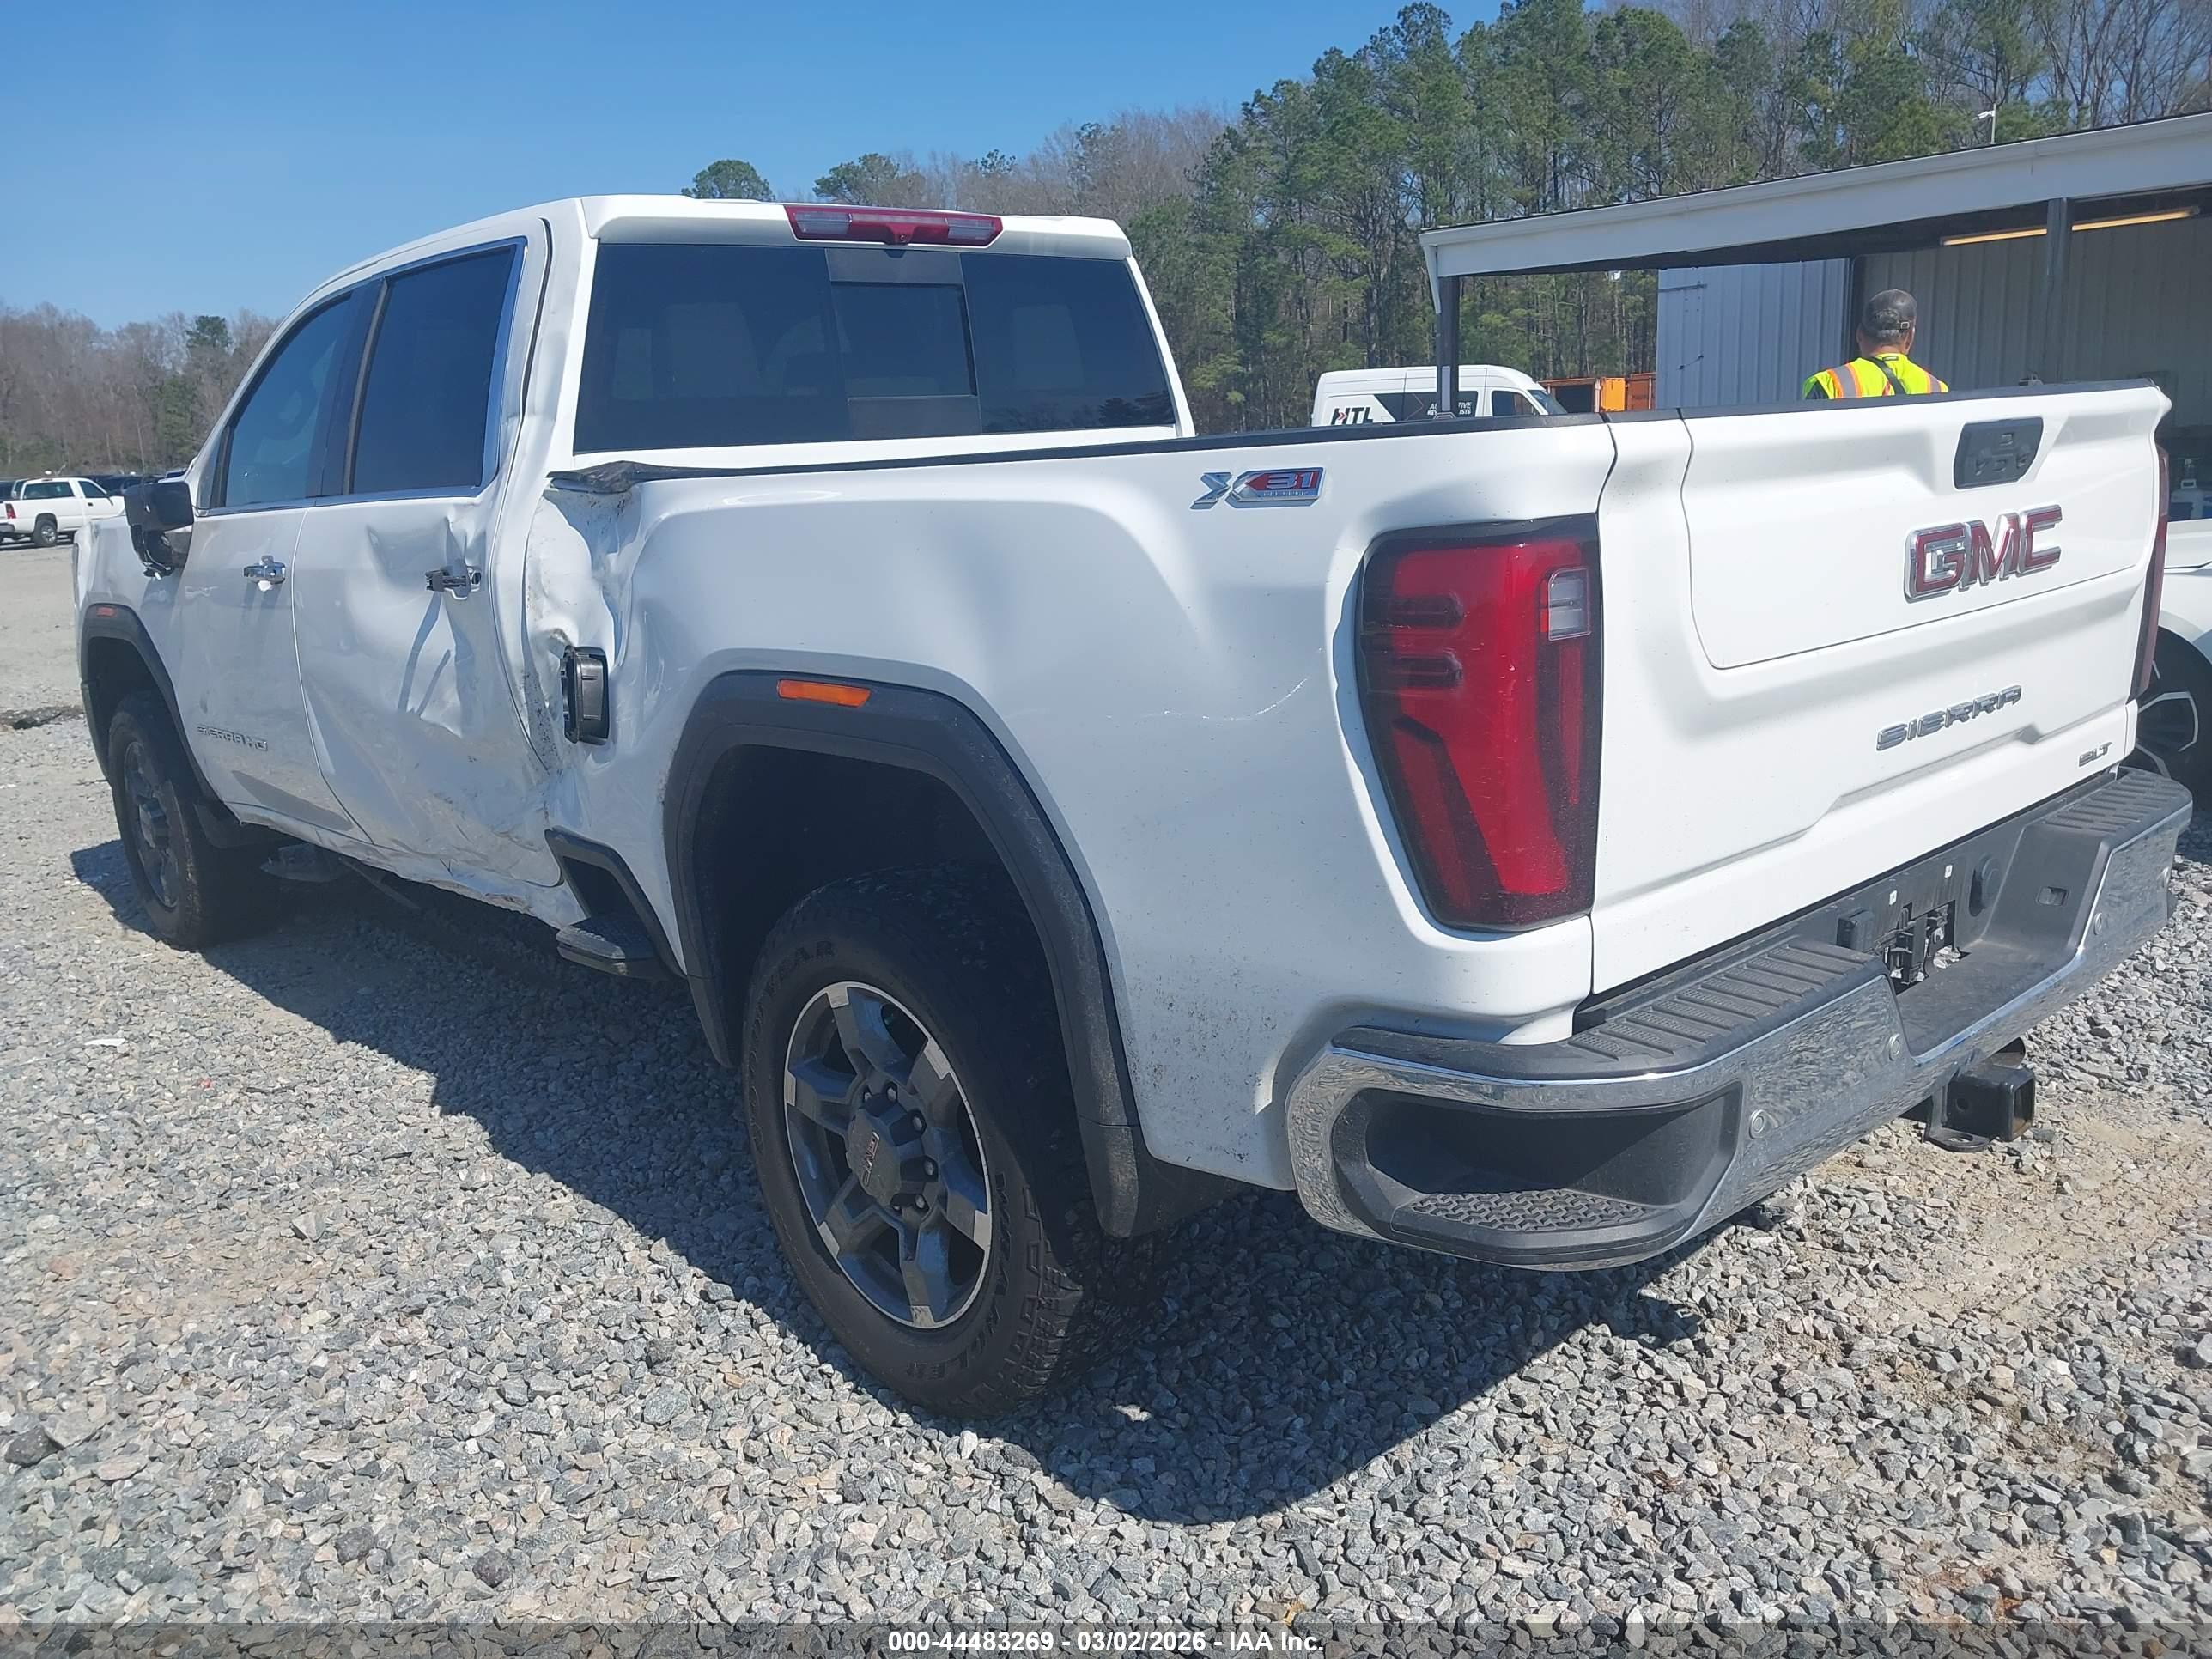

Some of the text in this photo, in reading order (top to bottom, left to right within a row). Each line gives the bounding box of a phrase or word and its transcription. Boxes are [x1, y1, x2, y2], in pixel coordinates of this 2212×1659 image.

[1905, 504, 2062, 604] GMC
[1876, 684, 2022, 751] SIERRA
[2078, 742, 2112, 767] SLT
[861, 1132, 879, 1186] GMC
